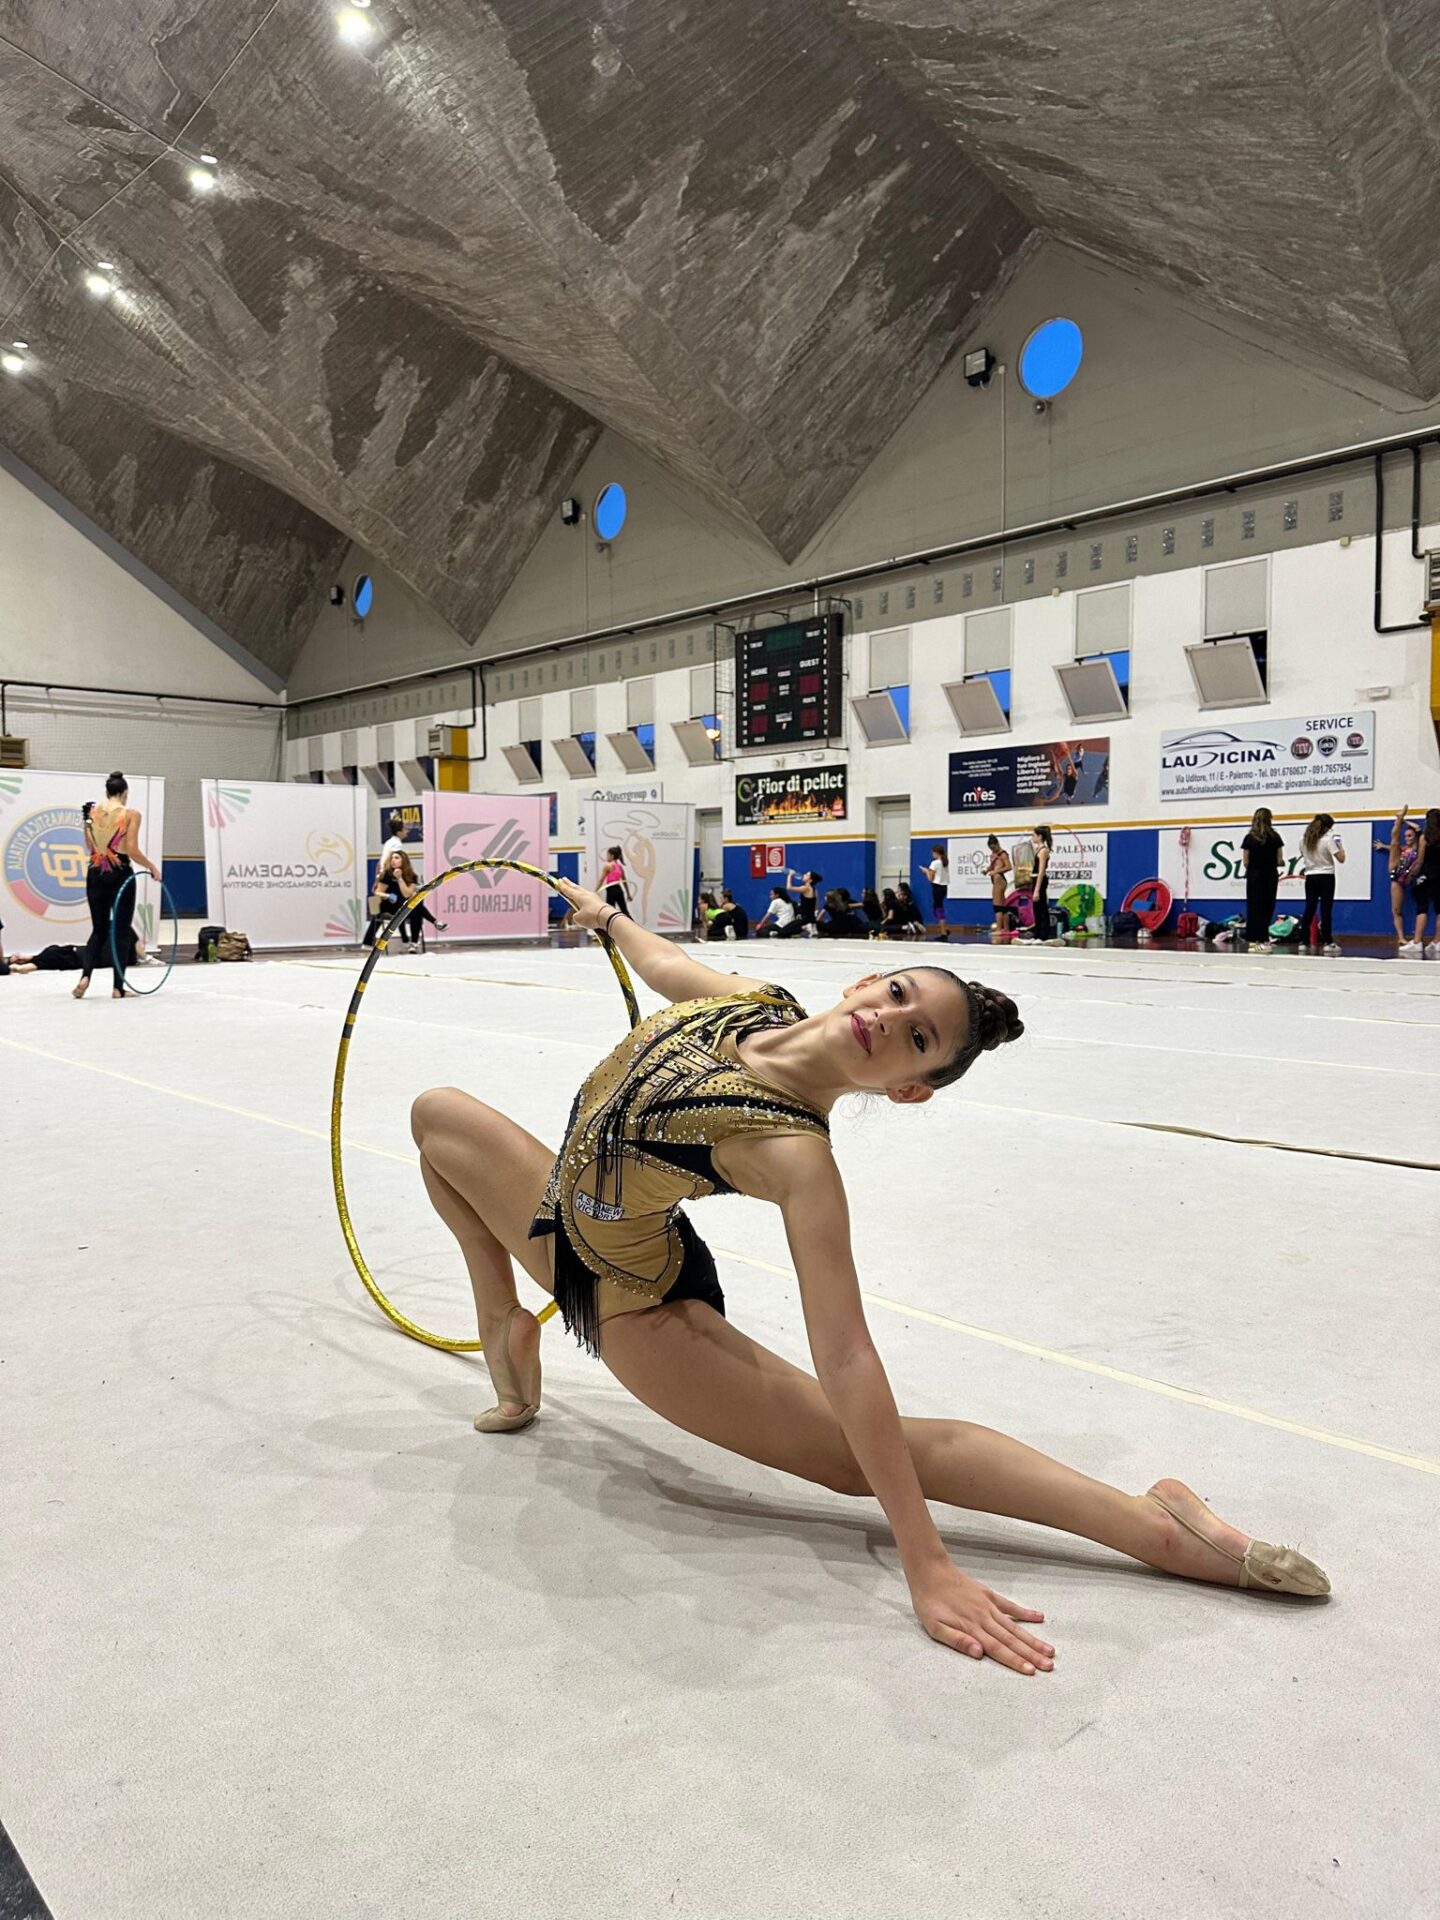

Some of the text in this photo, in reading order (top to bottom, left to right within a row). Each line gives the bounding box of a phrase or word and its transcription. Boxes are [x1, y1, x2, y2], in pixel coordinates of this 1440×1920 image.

[1306, 717, 1354, 731] SERVICE
[1175, 775, 1184, 783] Via
[1220, 771, 1225, 780] E
[1229, 771, 1253, 780] Palermo
[1259, 769, 1268, 777] Tel.
[757, 772, 844, 795] Fior di pellet
[1265, 780, 1283, 789] email:
[1056, 844, 1103, 853] PALERMO
